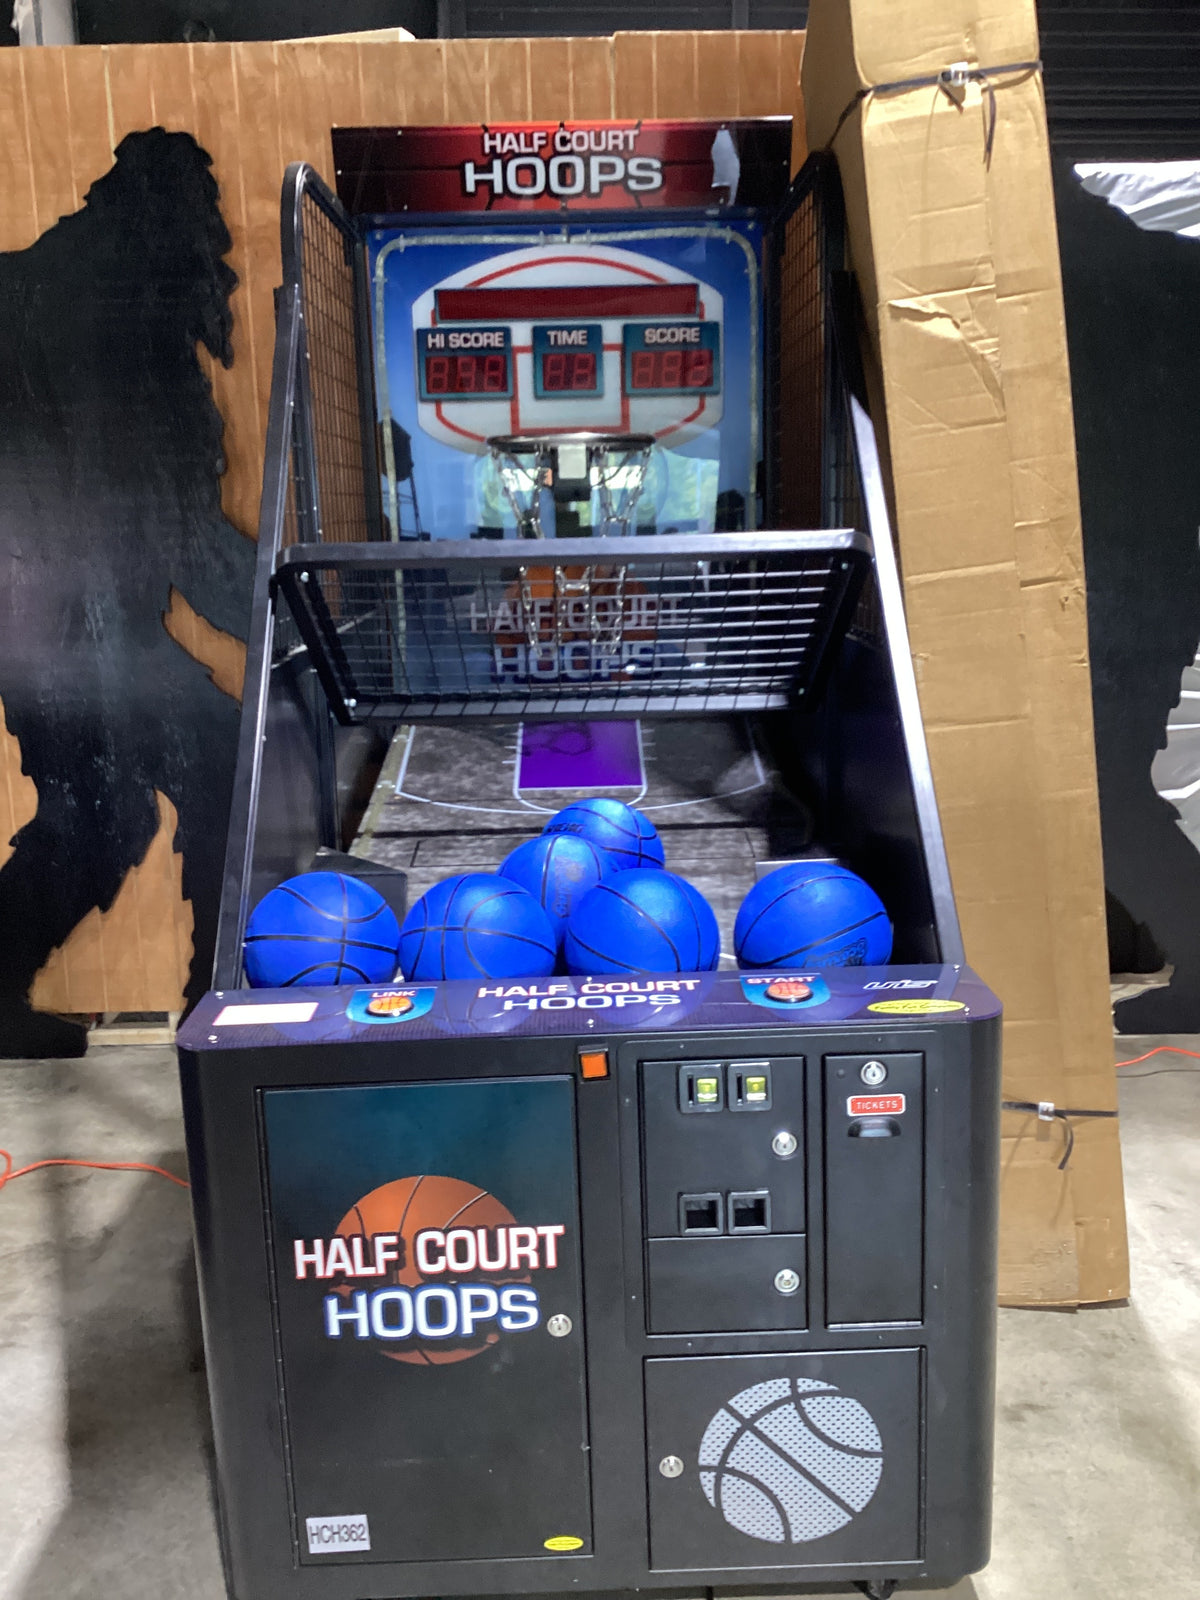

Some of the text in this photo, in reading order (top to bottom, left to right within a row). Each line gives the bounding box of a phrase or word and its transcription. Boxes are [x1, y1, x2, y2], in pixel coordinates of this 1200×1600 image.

[483, 129, 640, 154] HALF COURT
[464, 155, 663, 196] HOOPS
[427, 331, 505, 349] HI SCORE
[548, 329, 588, 346] TIME
[644, 326, 701, 344] SCORE
[477, 979, 702, 998] HALF COURT
[746, 975, 816, 984] START
[371, 990, 416, 998] LINK
[503, 993, 681, 1011] HOOPS
[856, 1100, 898, 1111] TICKETS
[294, 1224, 566, 1280] HALF COURT
[323, 1285, 542, 1340] HOOPS
[309, 1522, 368, 1545] HCH362
